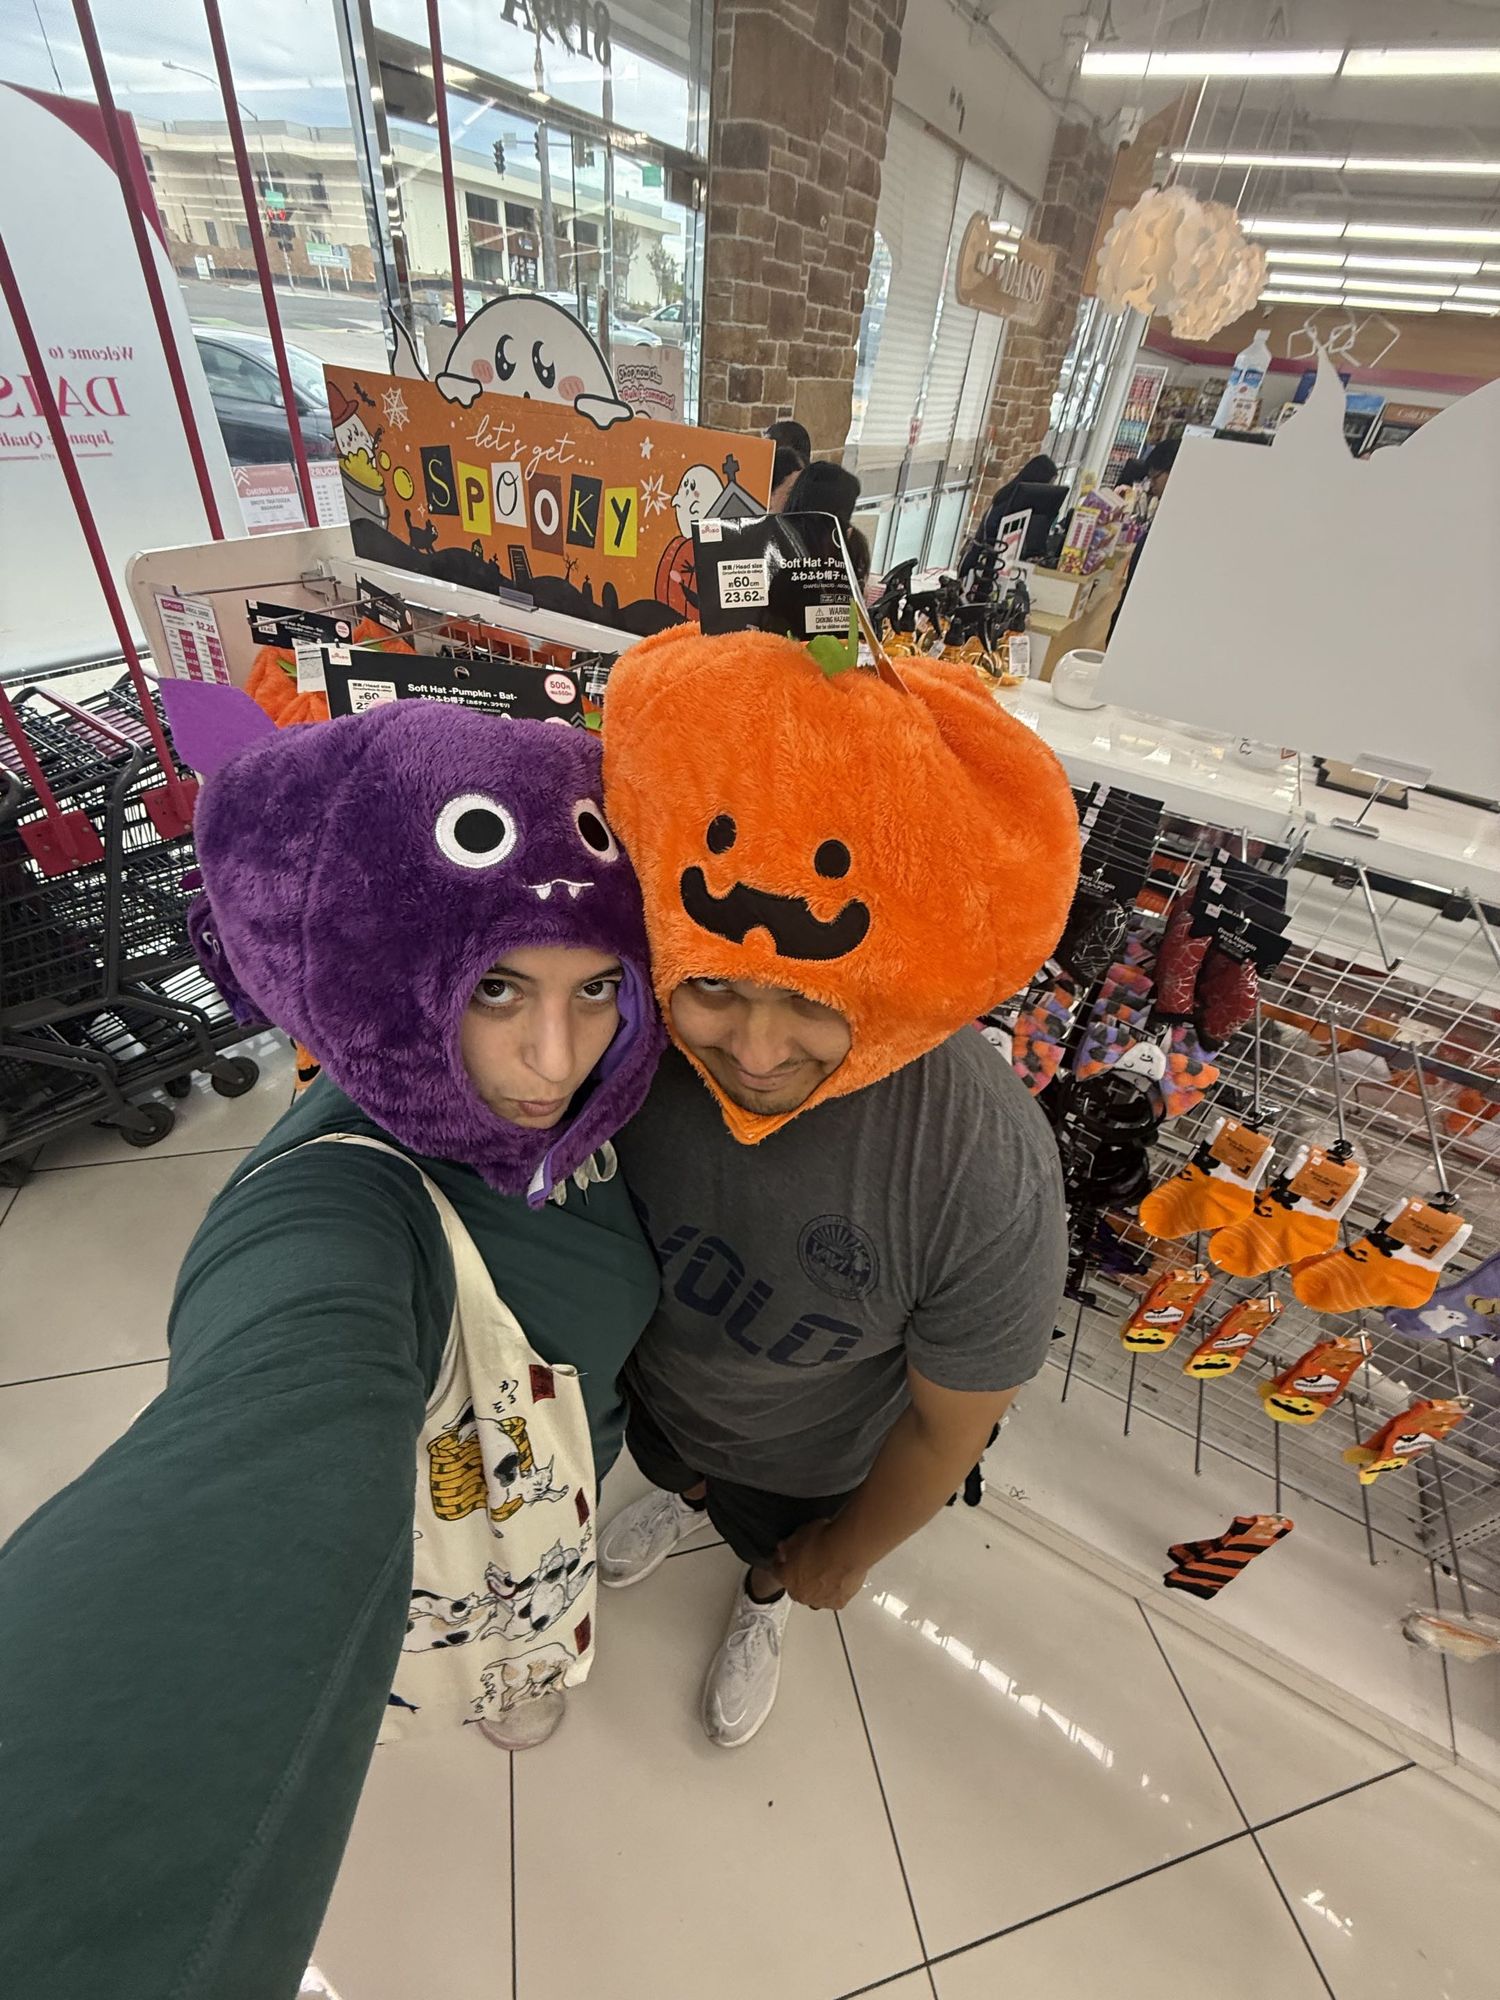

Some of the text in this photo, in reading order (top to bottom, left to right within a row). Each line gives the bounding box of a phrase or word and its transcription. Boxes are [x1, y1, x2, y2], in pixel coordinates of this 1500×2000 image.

[1003, 254, 1047, 305] DAISO
[618, 367, 634, 381] Shop
[636, 367, 649, 377] now
[466, 414, 527, 460] let's
[428, 458, 632, 549] SPOOKY
[780, 558, 800, 569] Soft
[803, 557, 821, 568] Hat
[408, 684, 428, 693] Soft
[430, 686, 447, 695] Hat
